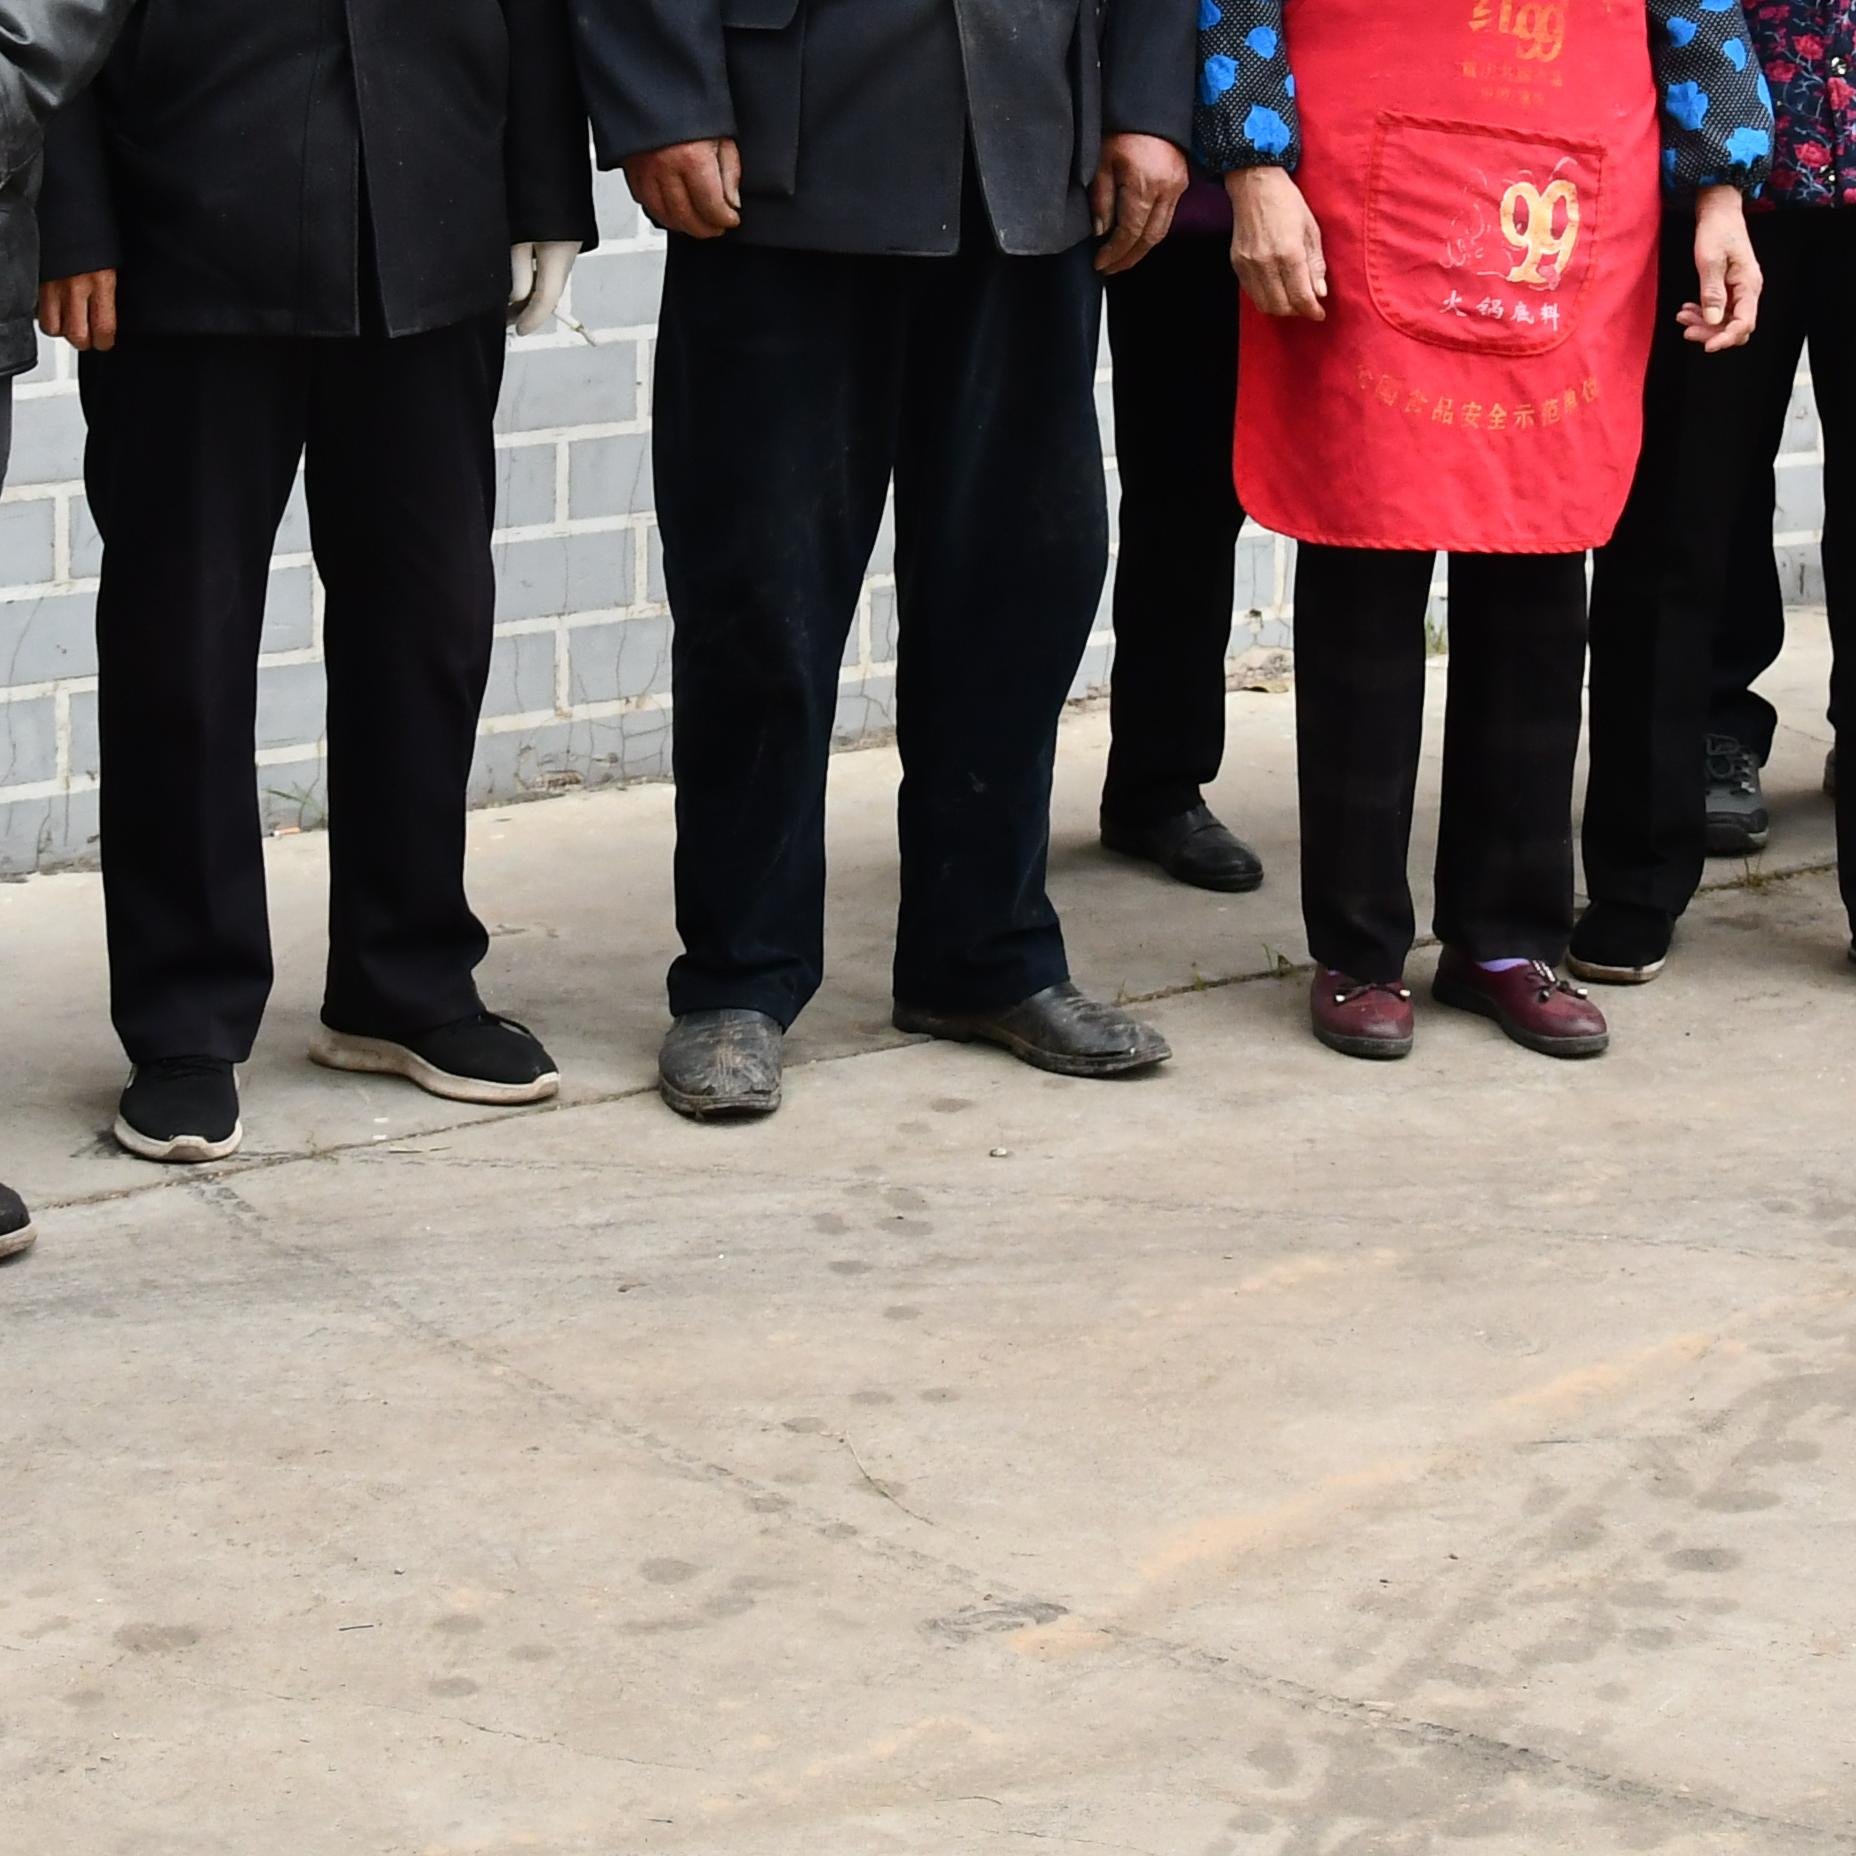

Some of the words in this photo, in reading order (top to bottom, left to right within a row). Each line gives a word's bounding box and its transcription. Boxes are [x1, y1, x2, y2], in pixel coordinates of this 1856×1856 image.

[1499, 179, 1580, 283] 99
[1439, 289, 1561, 332] 火锅底料
